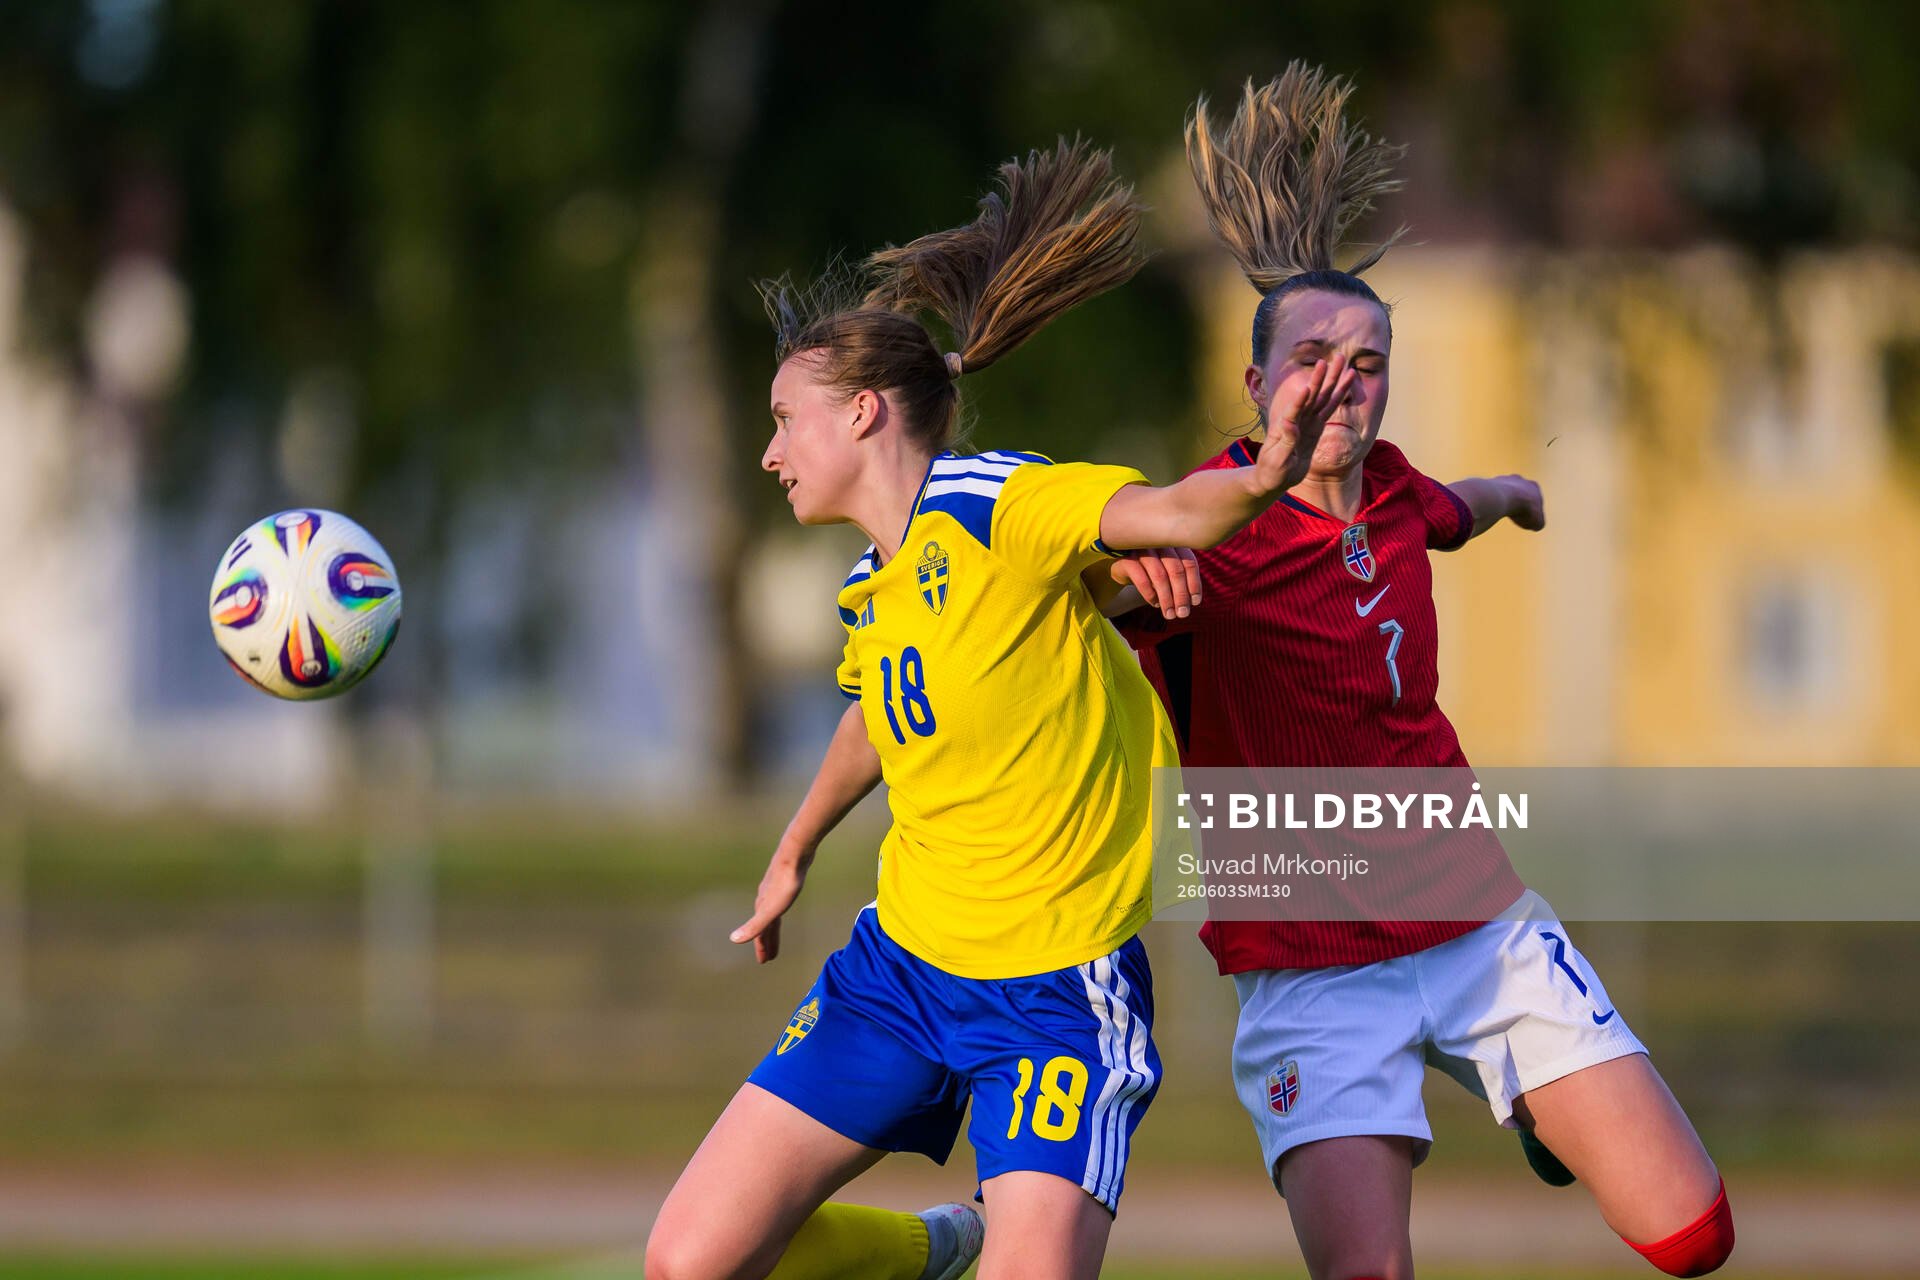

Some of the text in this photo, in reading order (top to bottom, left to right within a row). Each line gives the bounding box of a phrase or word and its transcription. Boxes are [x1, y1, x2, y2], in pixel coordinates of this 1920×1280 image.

[880, 645, 937, 745] 18
[1378, 618, 1405, 709] 7
[1539, 931, 1588, 999] 7
[1007, 1055, 1089, 1142] 18
